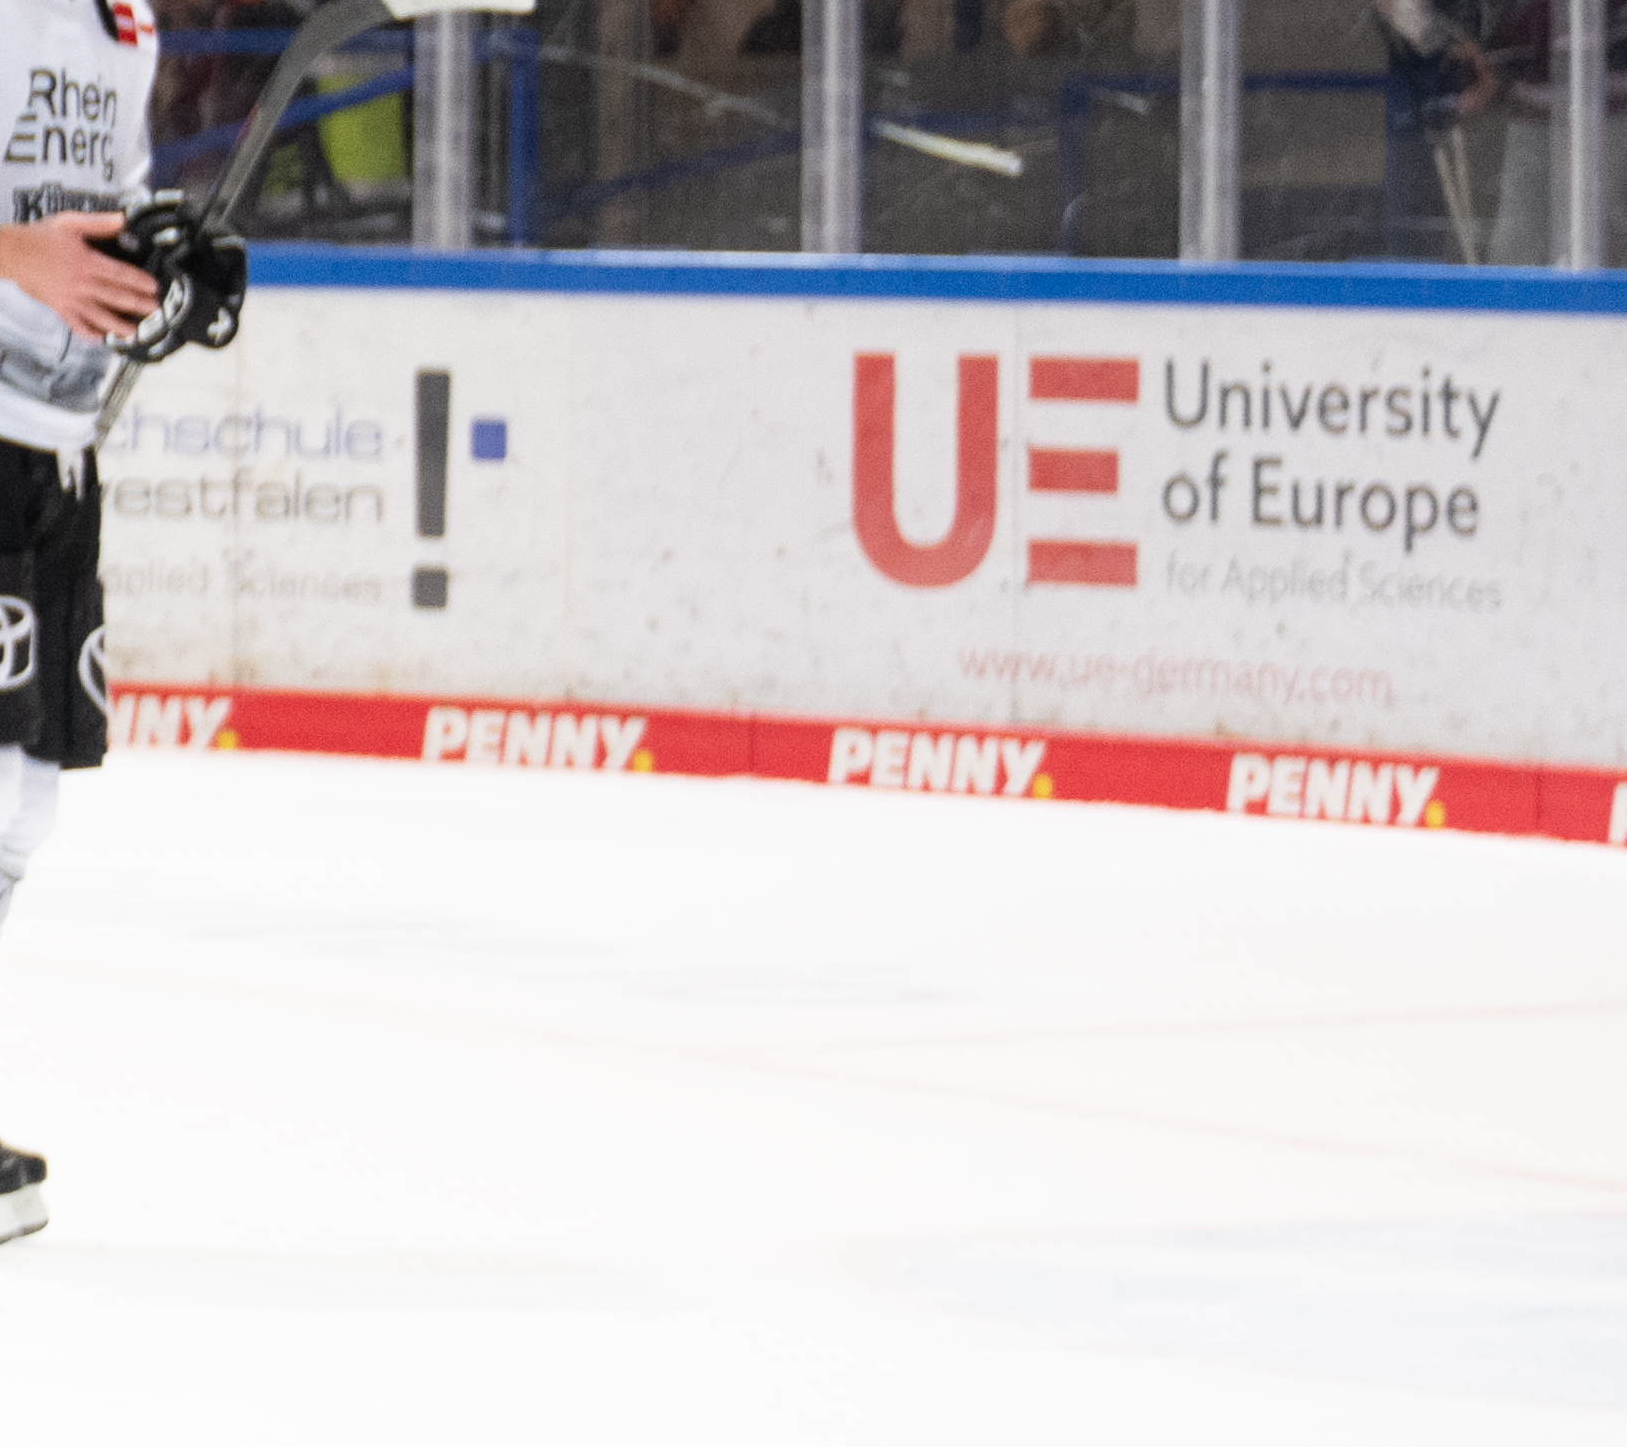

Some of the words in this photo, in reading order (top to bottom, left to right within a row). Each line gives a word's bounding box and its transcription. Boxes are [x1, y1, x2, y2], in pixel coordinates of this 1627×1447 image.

[1163, 358, 1502, 460] University
[851, 351, 1140, 590] UE
[1162, 452, 1228, 524] of
[1249, 456, 1481, 555] Europe
[1165, 556, 1211, 596] for
[1223, 552, 1350, 611] Applied
[1357, 562, 1504, 612] Sciences
